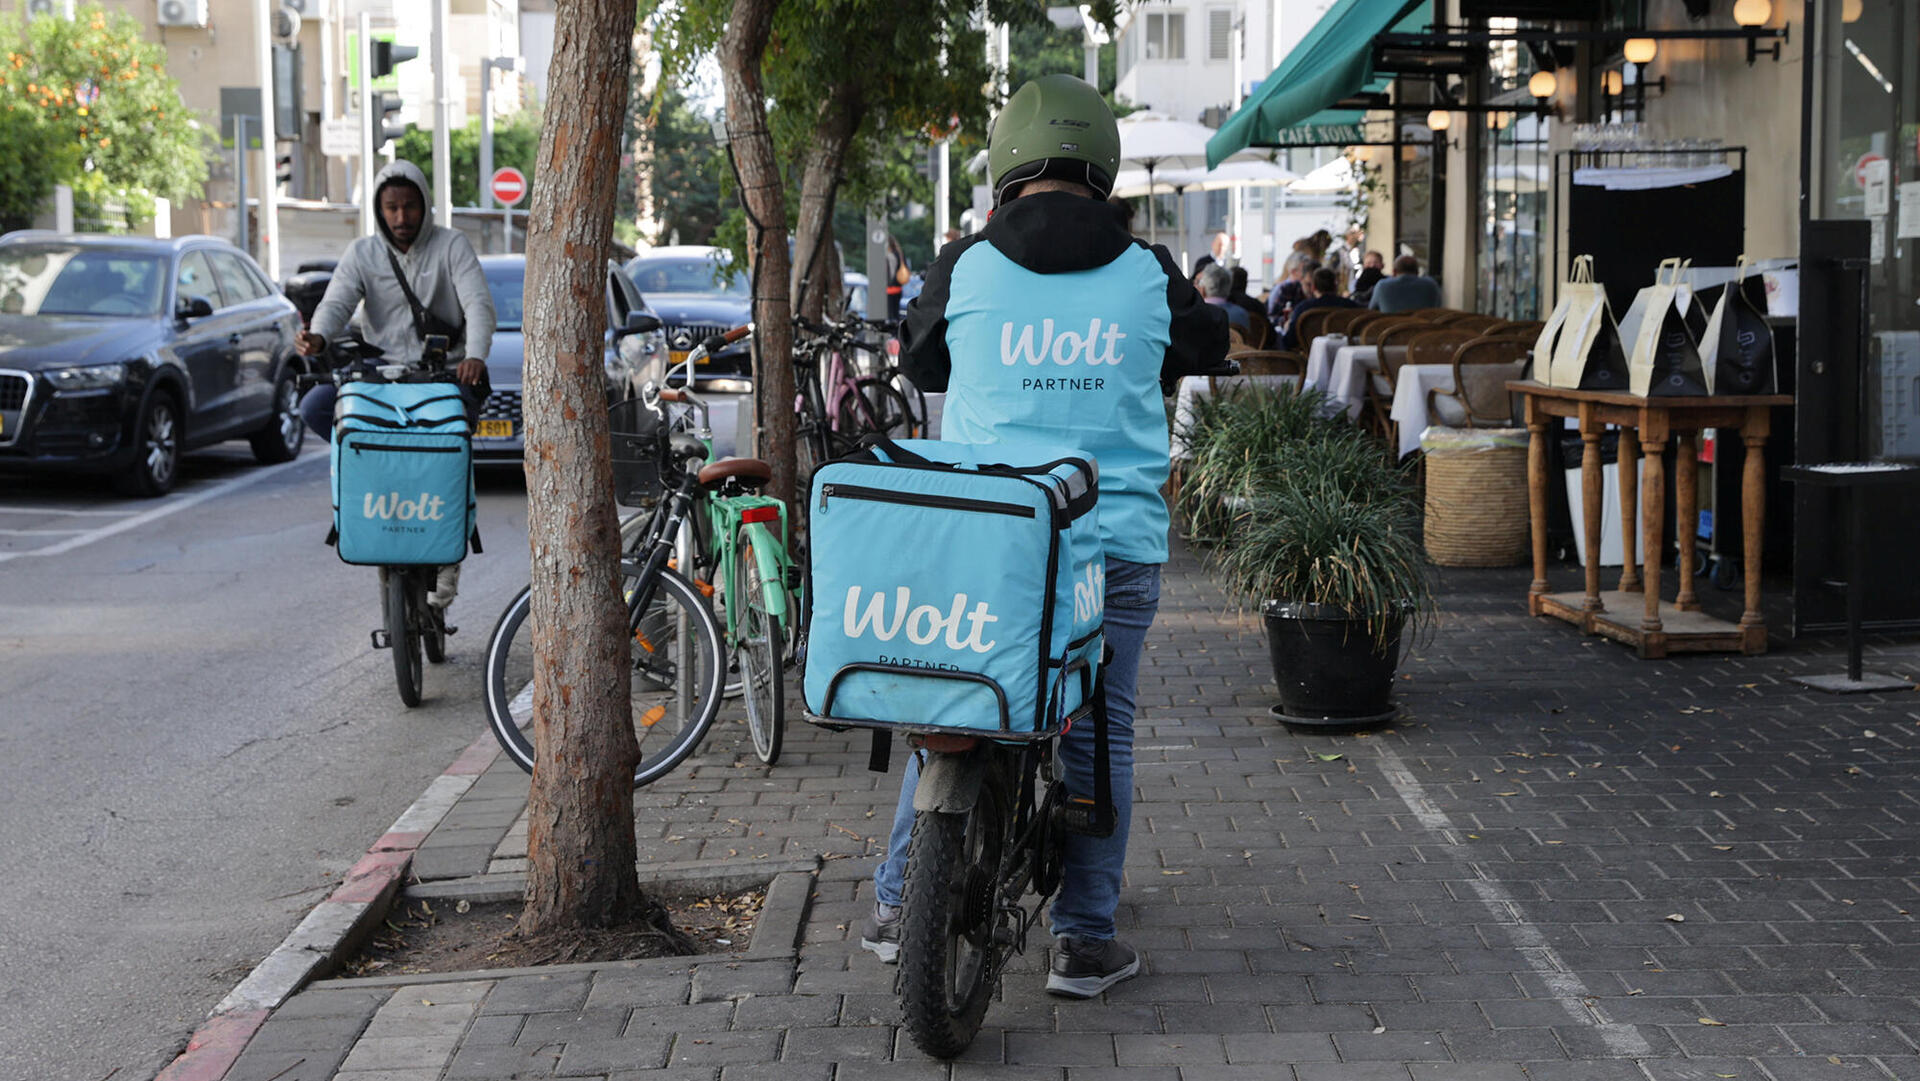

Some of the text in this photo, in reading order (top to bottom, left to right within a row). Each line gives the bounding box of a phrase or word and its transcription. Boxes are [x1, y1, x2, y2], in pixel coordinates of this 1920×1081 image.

[1278, 123, 1315, 144] CAFÉ
[1001, 318, 1127, 366] Wolt
[1022, 378, 1105, 391] PARTNER
[364, 492, 445, 520] Wolt
[382, 525, 425, 534] PARTNER
[1074, 562, 1104, 624] olt
[844, 585, 998, 653] Wolt
